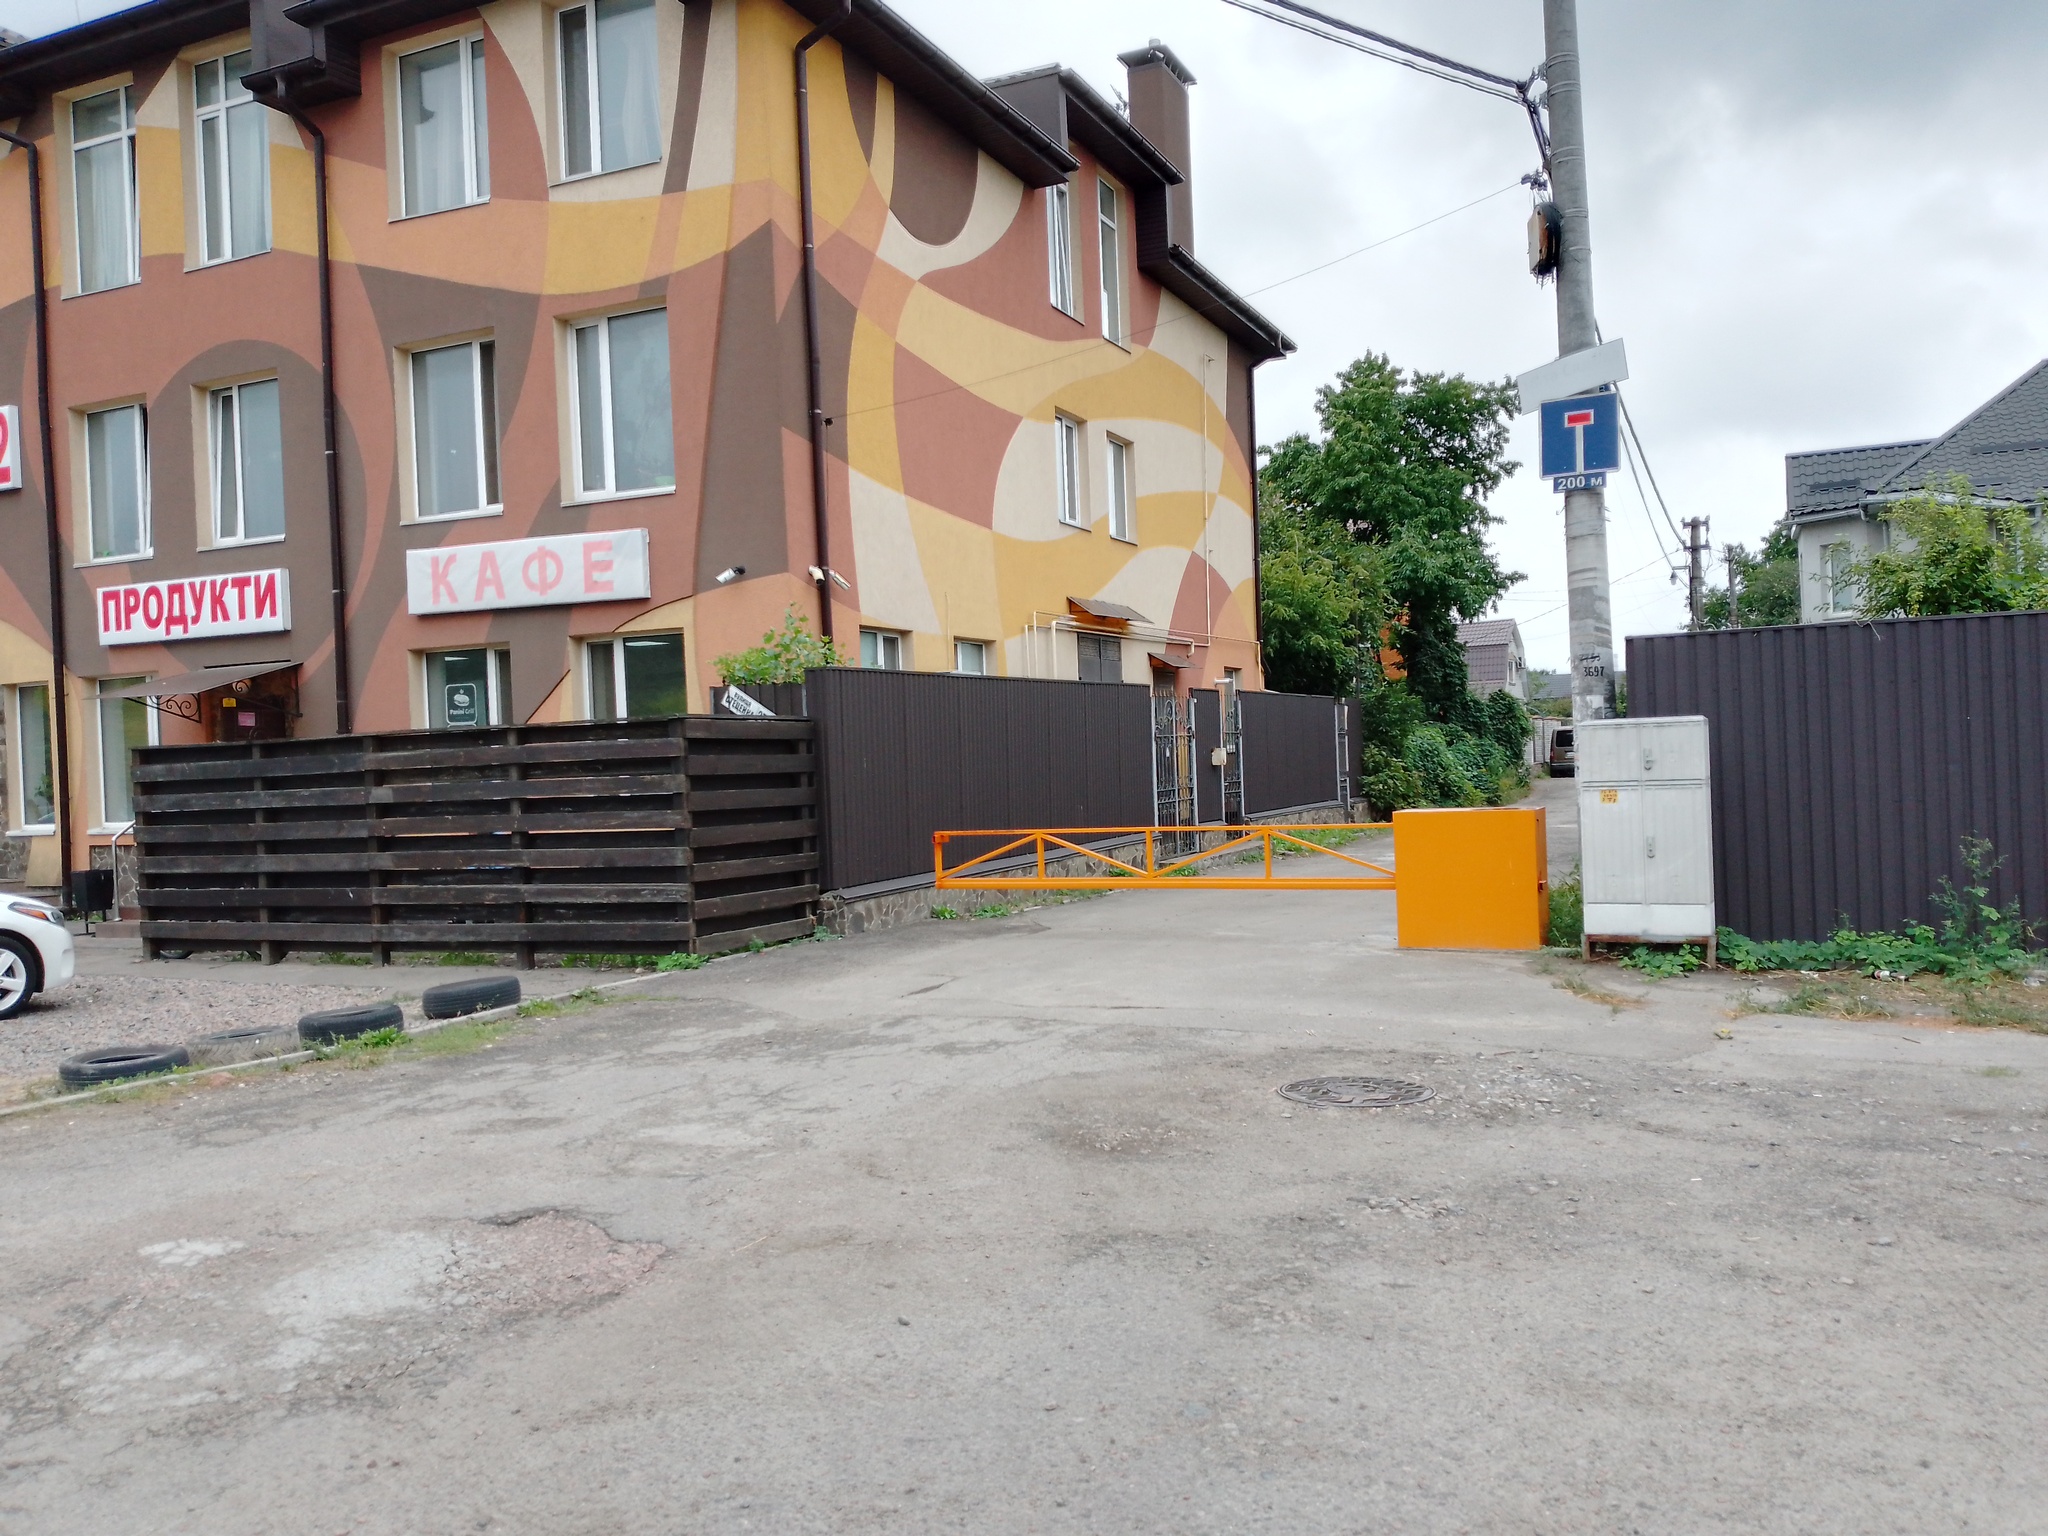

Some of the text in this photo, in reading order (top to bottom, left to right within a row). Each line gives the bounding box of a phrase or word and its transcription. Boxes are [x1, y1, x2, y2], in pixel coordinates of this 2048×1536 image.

[1557, 475, 1586, 490] 200
[431, 540, 615, 605] КАФЕ
[102, 573, 278, 637] ПРОДУКТИ
[1583, 665, 1605, 677] 3697
